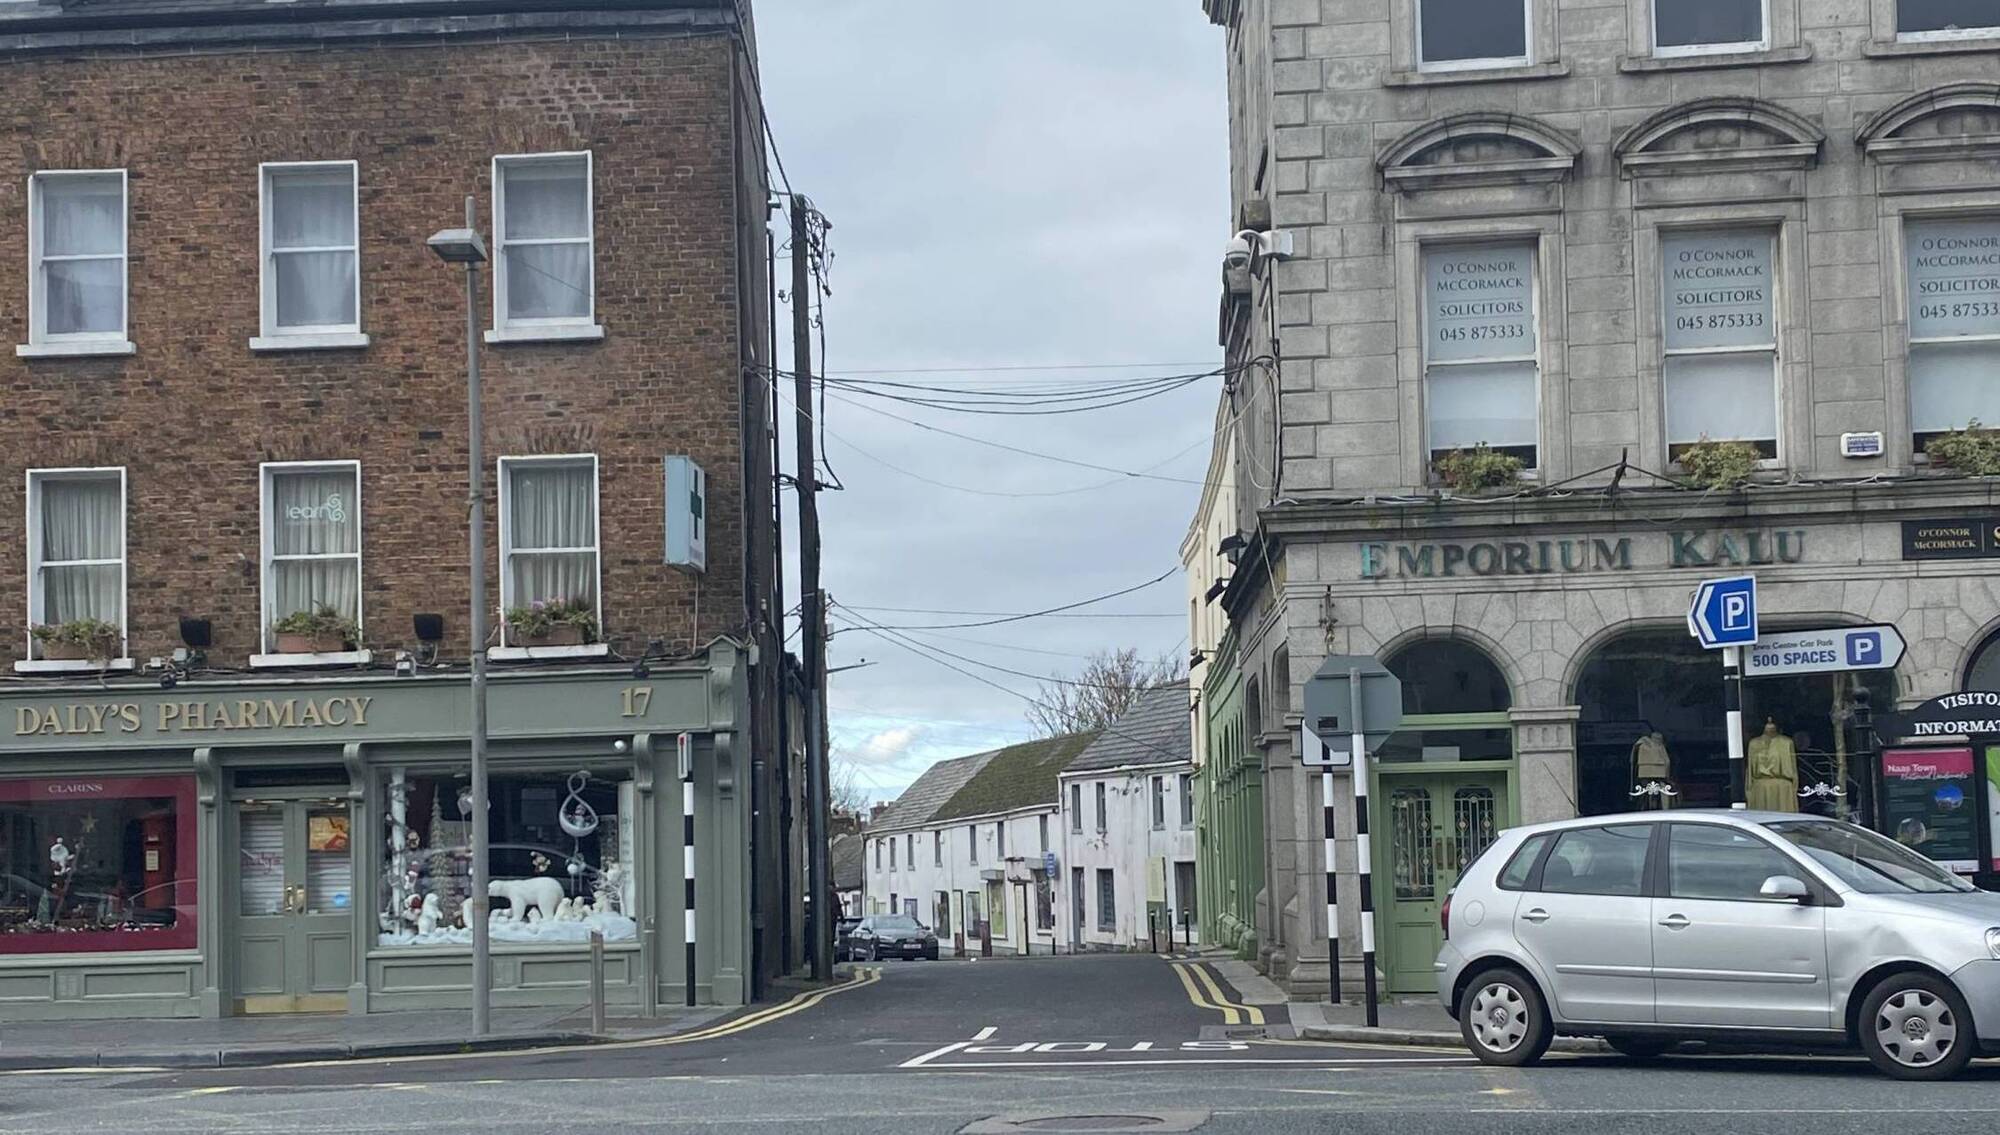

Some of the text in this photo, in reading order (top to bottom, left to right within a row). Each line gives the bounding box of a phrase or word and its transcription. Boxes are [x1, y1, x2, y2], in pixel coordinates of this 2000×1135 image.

[1916, 254, 2000, 268] McCORMAC
[1919, 278, 2000, 294] SOLICITOR
[1676, 289, 1762, 305] SOLICITORS
[1439, 302, 1524, 317] SOLICITORS
[1920, 302, 2000, 318] 045 87533
[1677, 312, 1763, 330] 045 875333
[1440, 324, 1524, 341] 045 875333
[1918, 528, 1970, 537] O'CONNOR
[1358, 529, 1807, 579] EMPORIUM KALU
[1799, 640, 1815, 648] Car
[1816, 638, 1833, 647] Park
[1753, 650, 1836, 667] 500 SPACES
[621, 687, 652, 718] 17
[15, 697, 372, 736] DALY'S PHARMACY
[1912, 763, 1936, 772] Town
[48, 783, 103, 793] CLARINS
